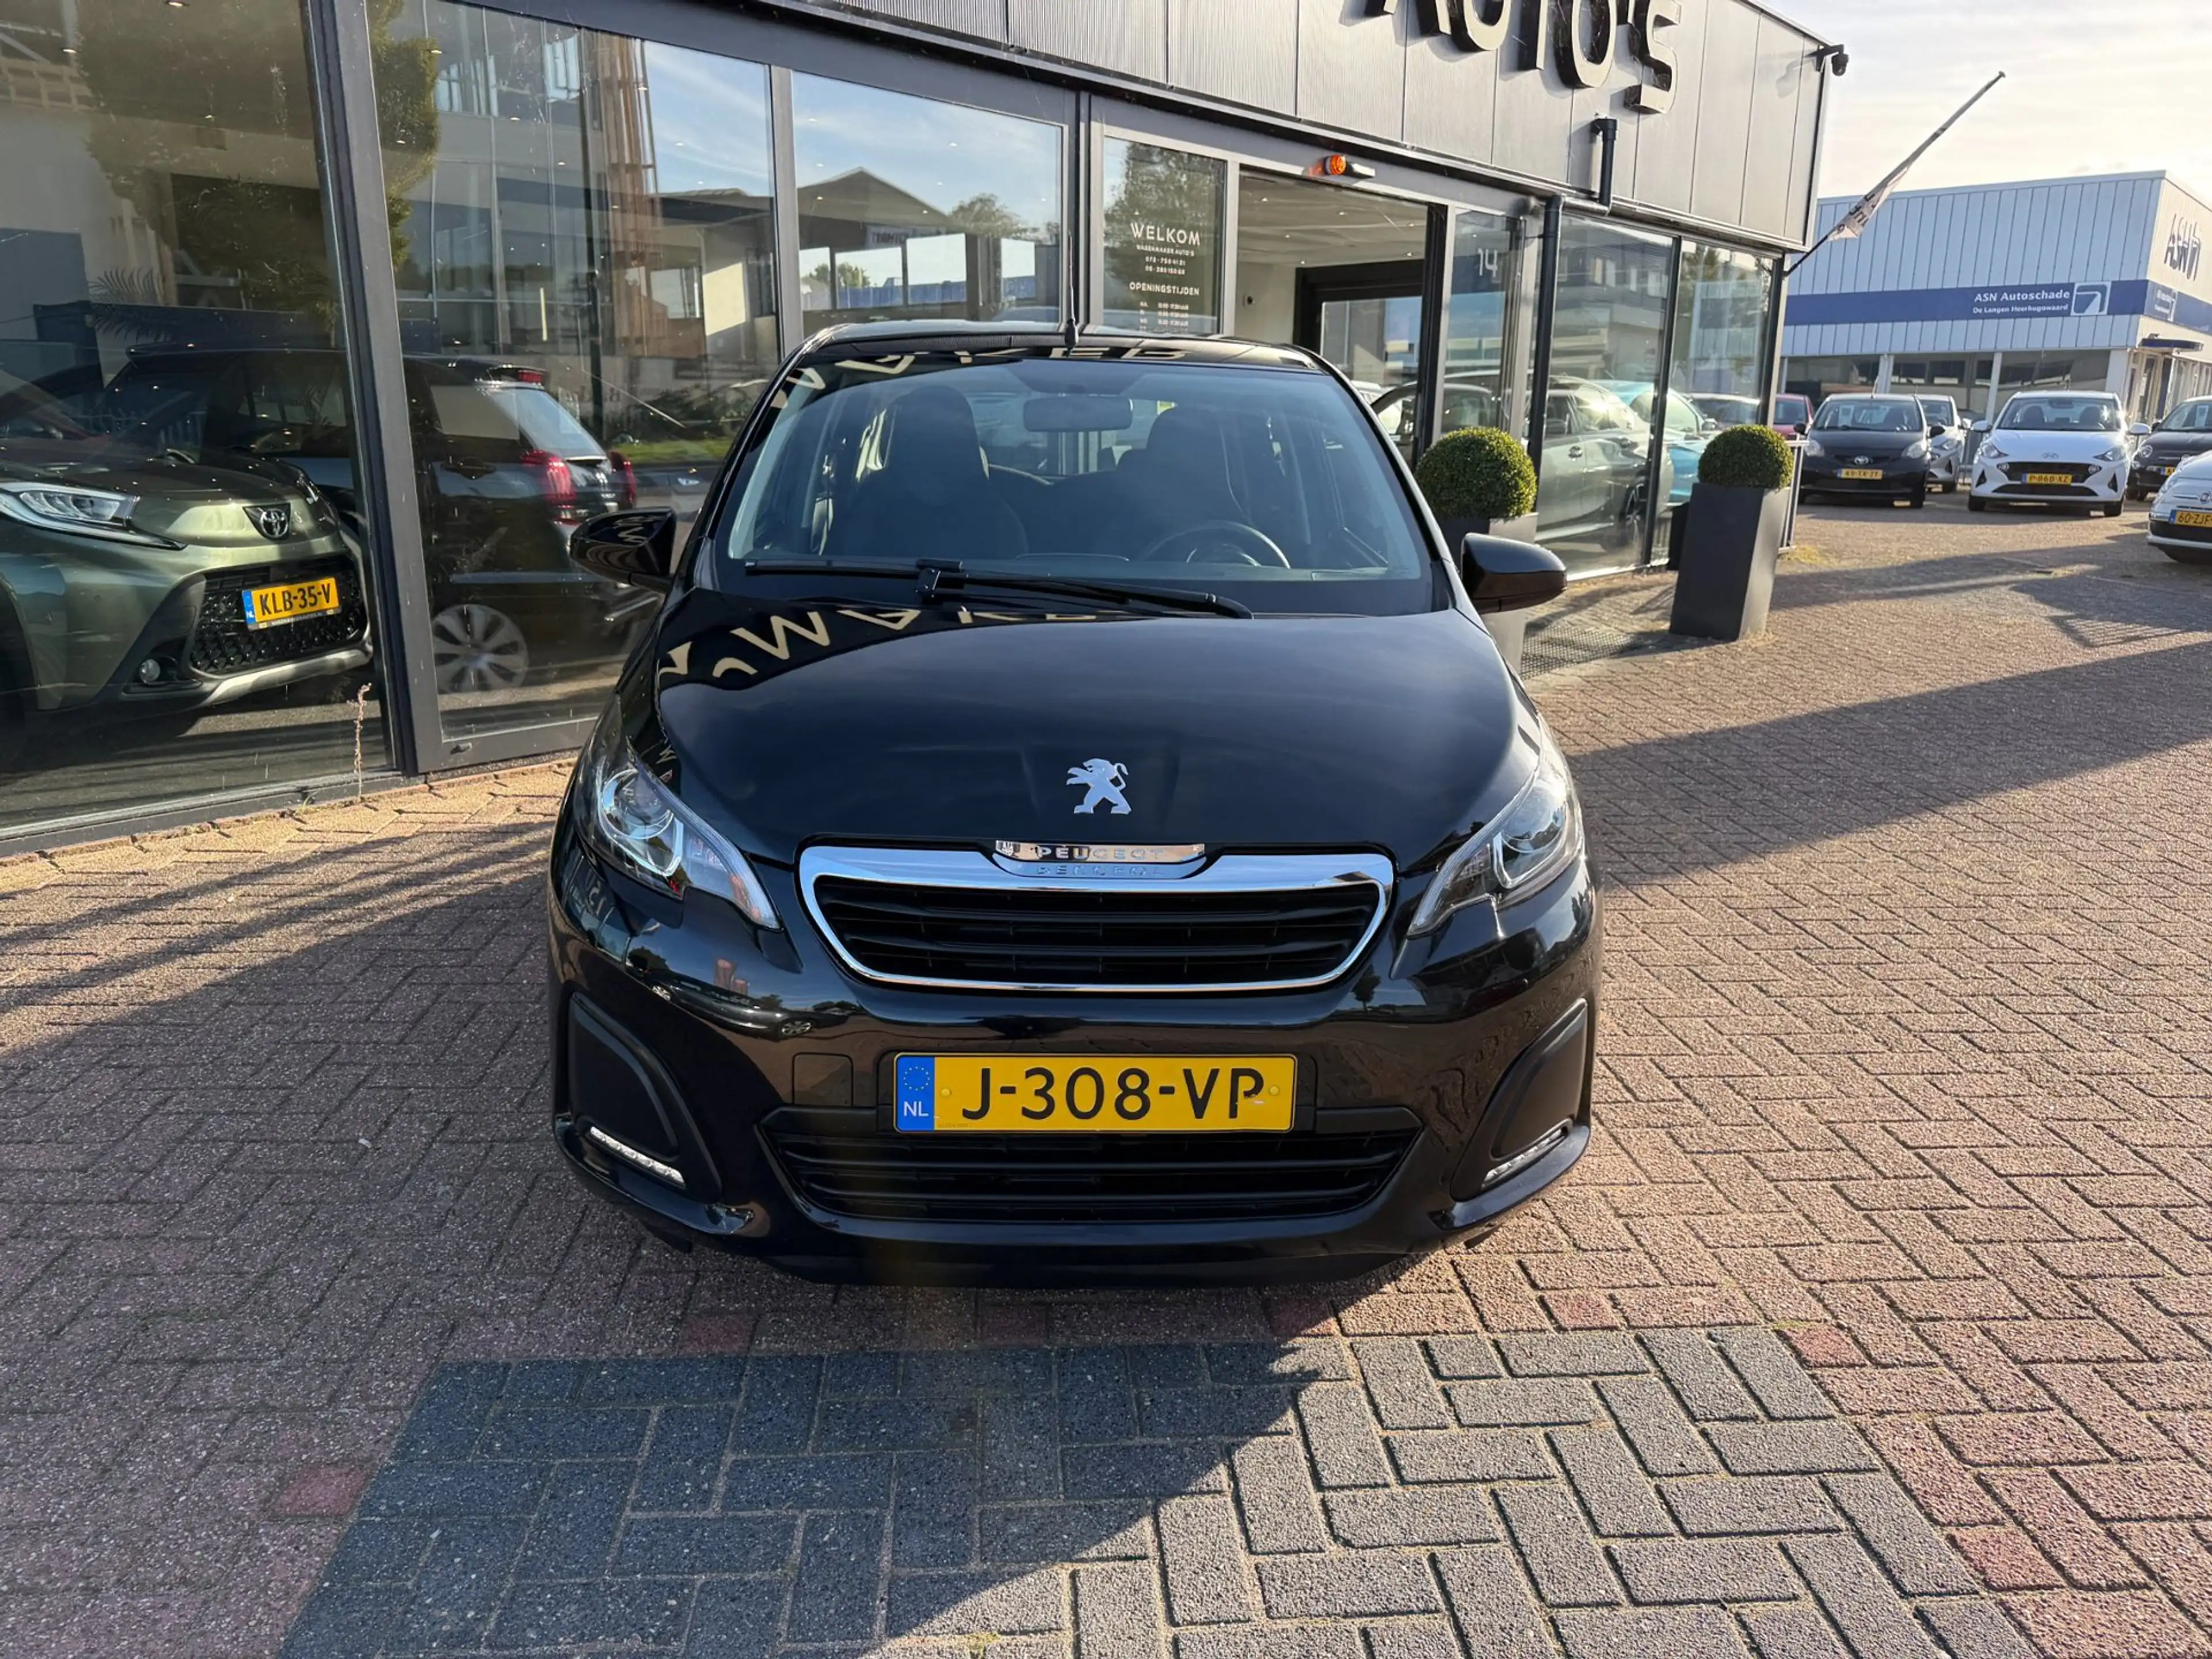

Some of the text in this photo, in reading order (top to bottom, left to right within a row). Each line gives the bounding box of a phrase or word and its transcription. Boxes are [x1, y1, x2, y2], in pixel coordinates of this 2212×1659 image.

[1130, 222, 1200, 246] WELKOM
[1478, 248, 1498, 277] 14
[1129, 282, 1200, 296] OPENINGSTIJDEN
[1974, 289, 2070, 302] ASN Autoschade
[1983, 306, 2010, 314] Langen
[2179, 512, 2212, 525] 60-ZJF
[260, 583, 331, 616] KLB-35-V
[1037, 845, 1164, 860] PEUGEOT
[903, 1067, 1264, 1120] NL J-308-VP
